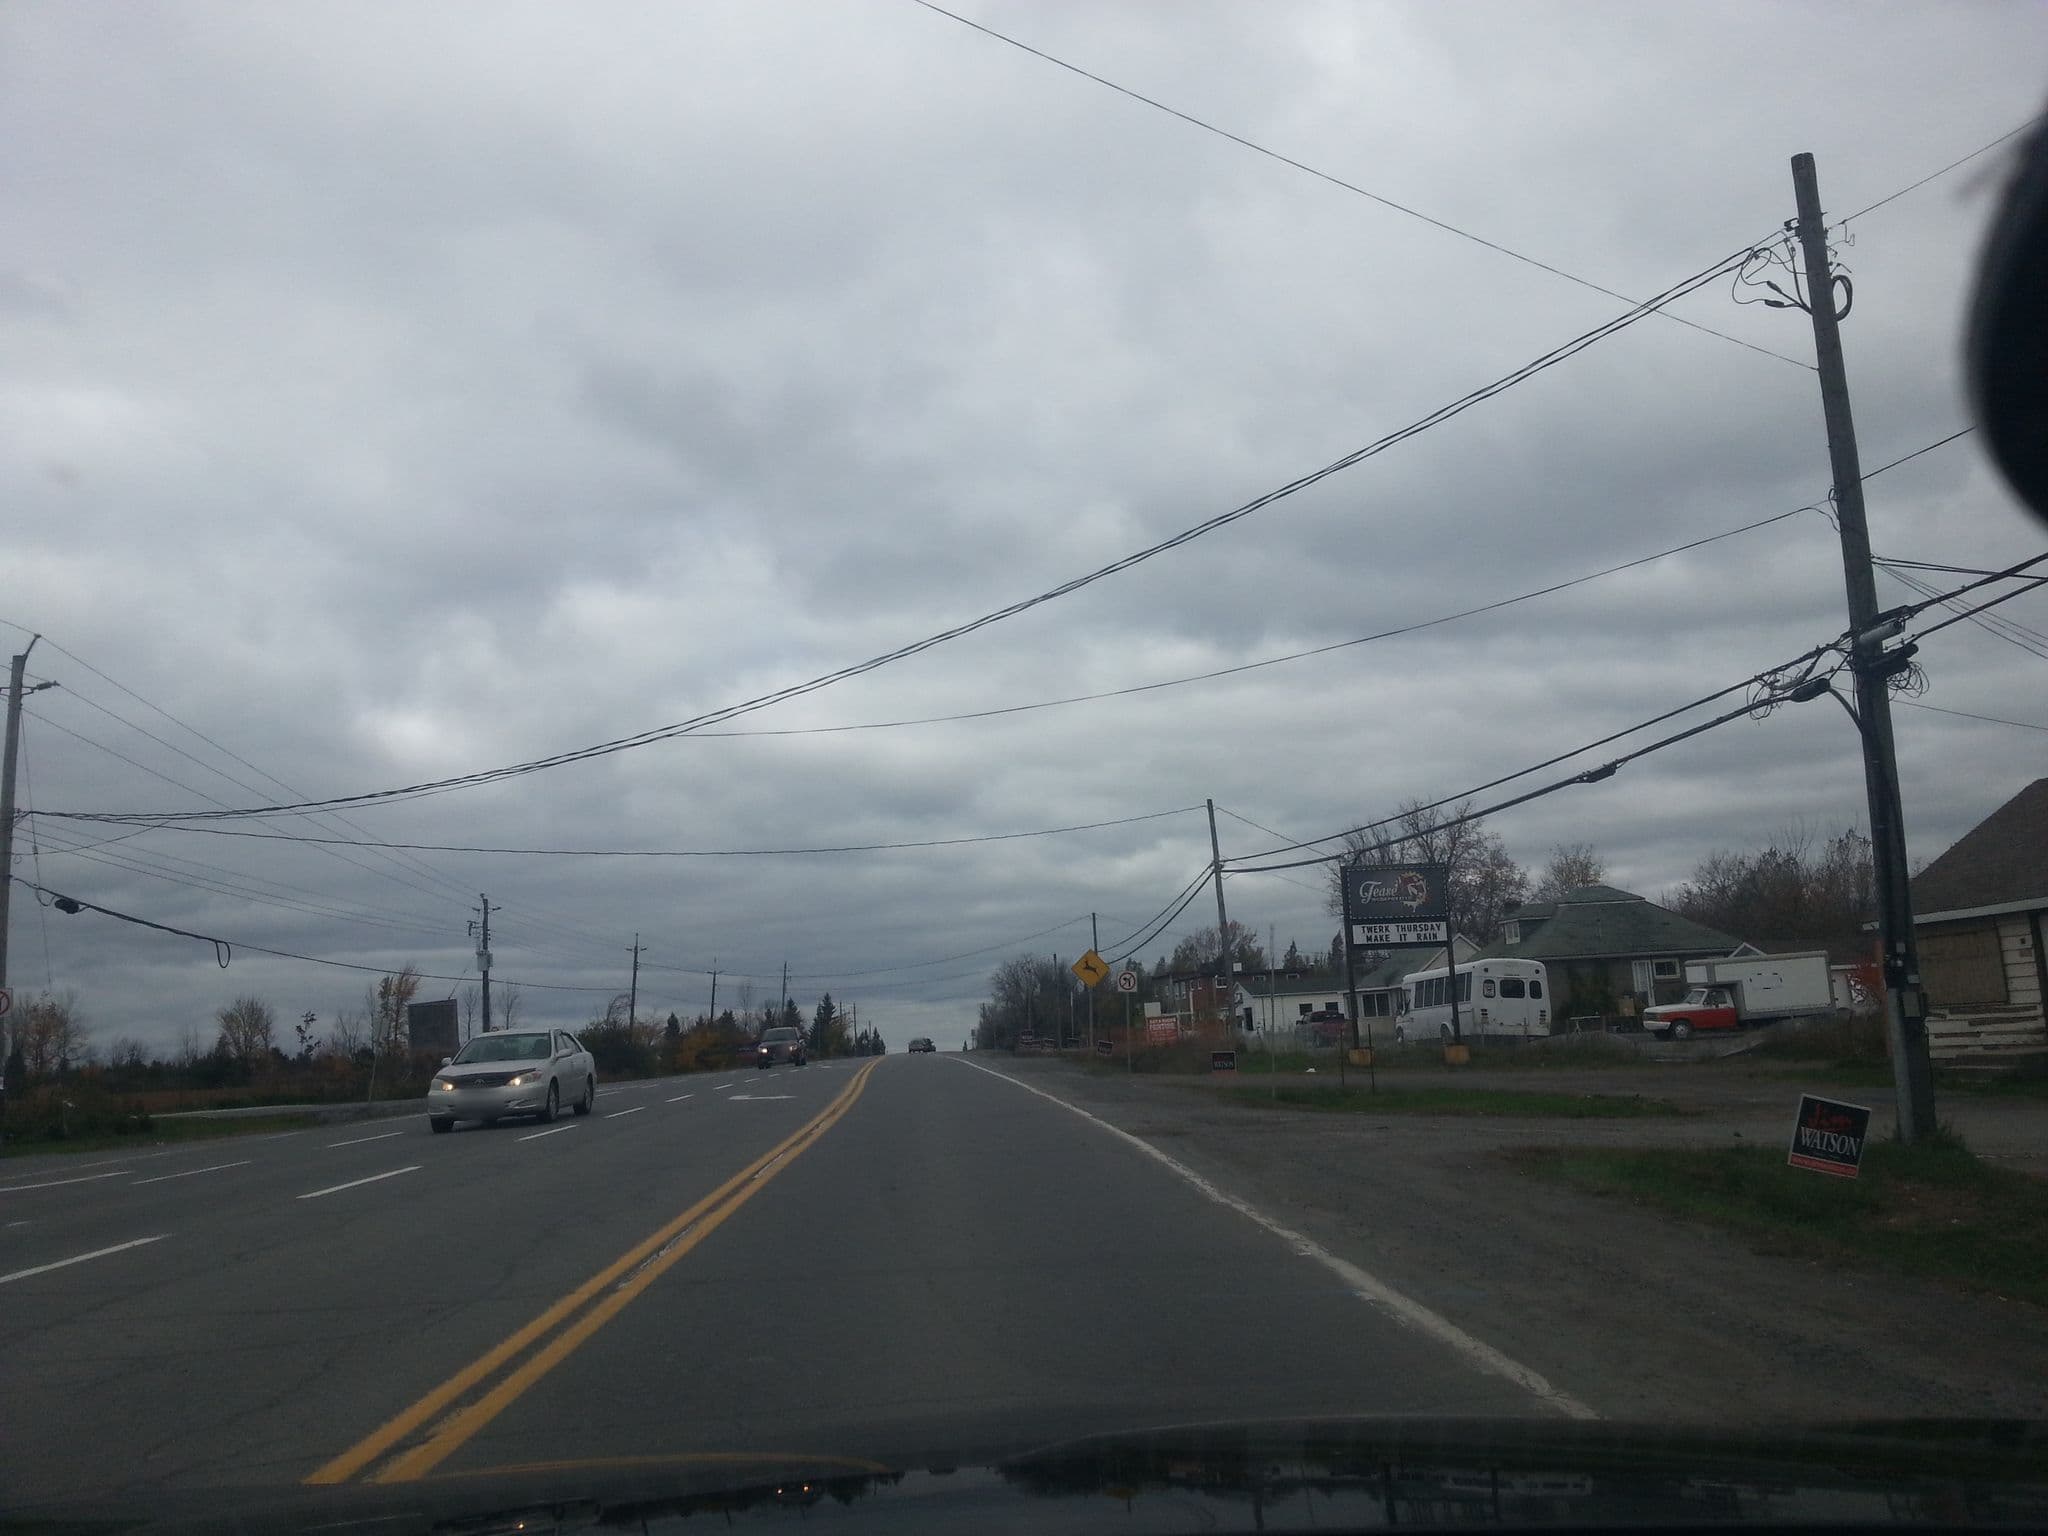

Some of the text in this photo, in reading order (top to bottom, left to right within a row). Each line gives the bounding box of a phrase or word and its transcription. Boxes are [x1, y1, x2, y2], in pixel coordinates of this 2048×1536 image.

[1361, 923, 1441, 933] TWERK THURSDAY
[1366, 933, 1438, 942] MAKE IT RAIN
[1800, 1126, 1860, 1157] WATSON
